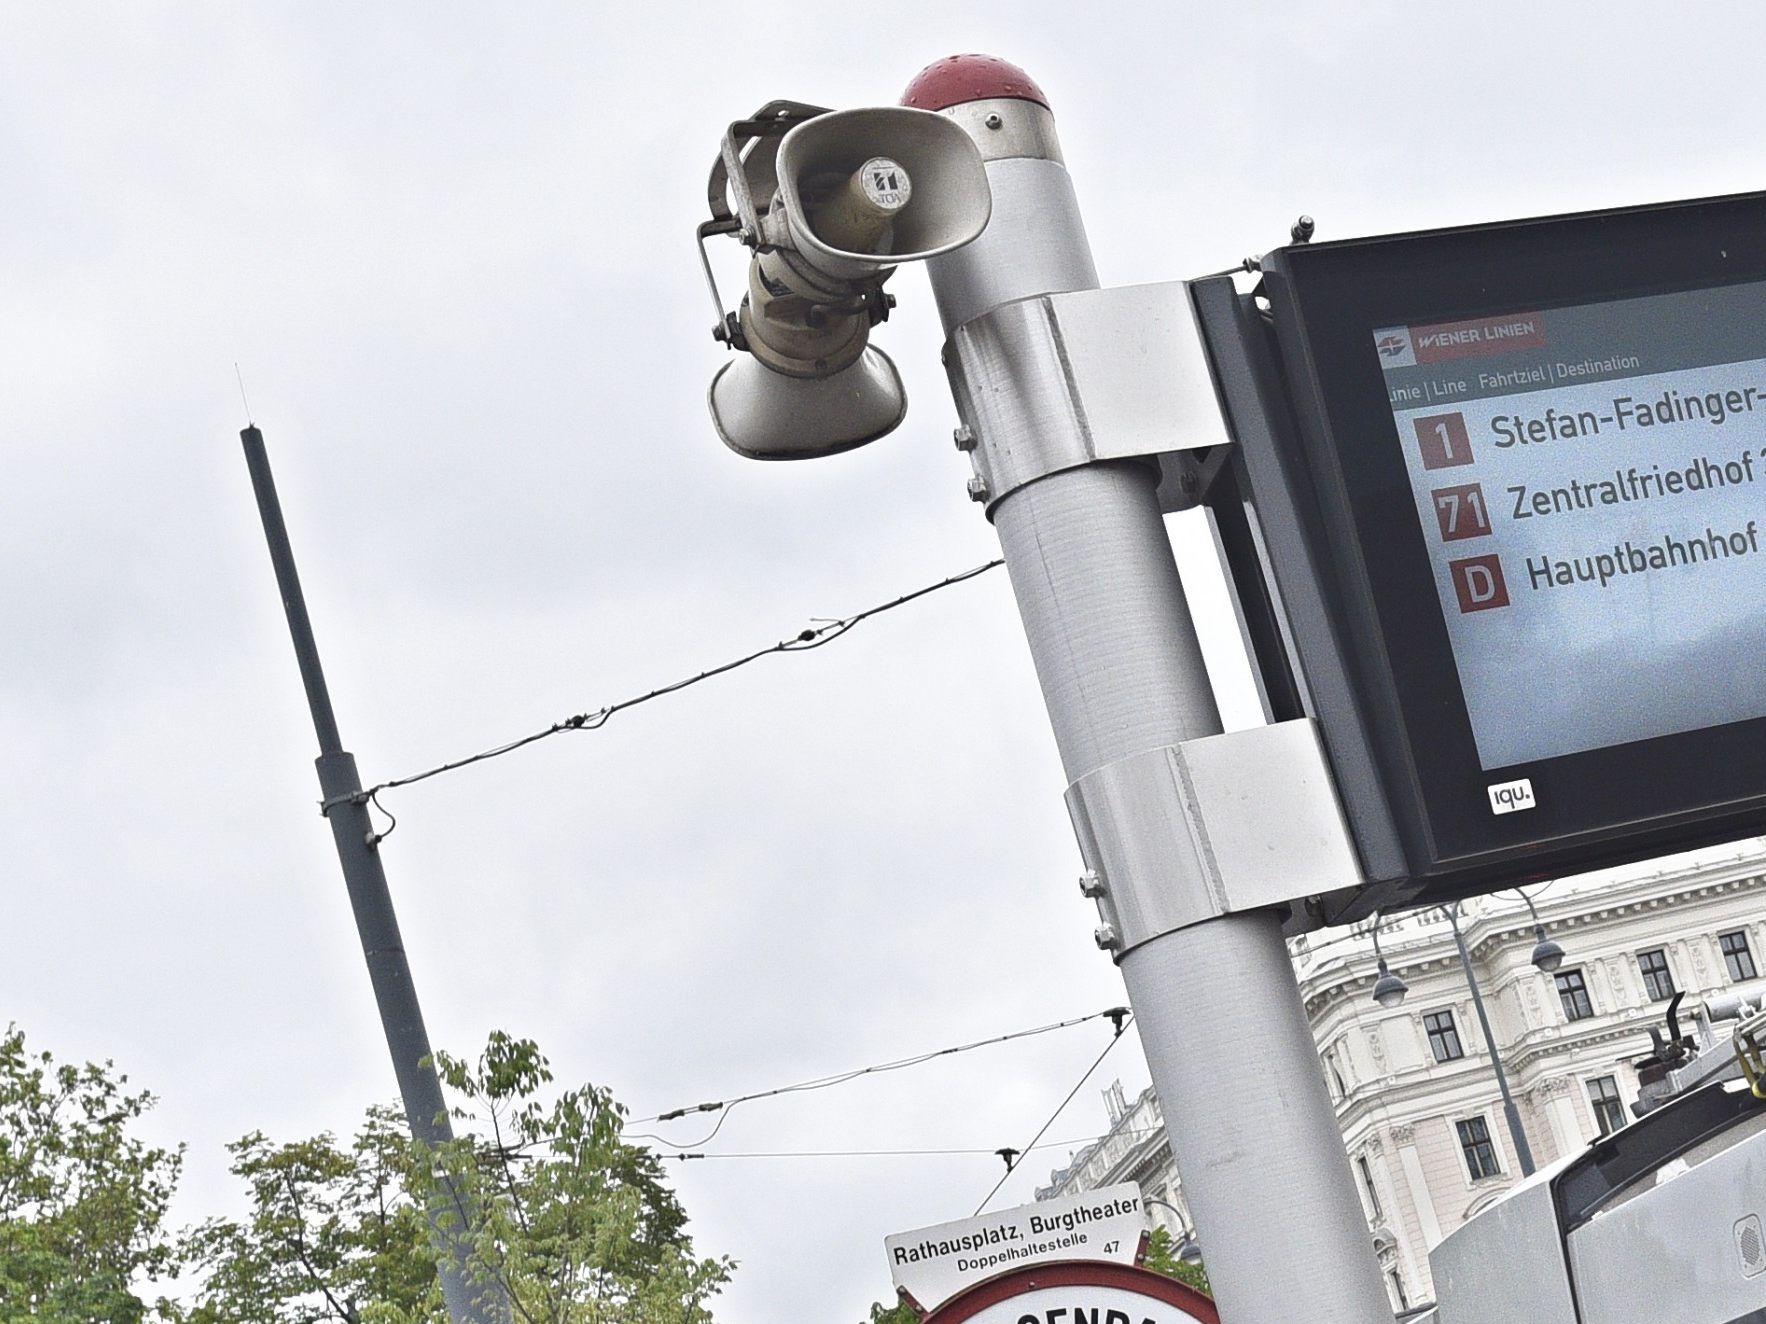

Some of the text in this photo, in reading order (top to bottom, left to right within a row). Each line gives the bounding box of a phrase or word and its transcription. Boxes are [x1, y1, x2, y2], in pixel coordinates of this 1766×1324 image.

[1418, 321, 1535, 348] WIENER LINIEN
[1389, 354, 1640, 402] inie Line Fahrtziel Destination
[1434, 422, 1454, 459] 1
[1438, 490, 1488, 534] 71
[1507, 451, 1754, 521] Zentralfriedhof
[1464, 563, 1496, 605] D
[1525, 521, 1759, 591] Hauptbahnhof
[893, 1196, 1140, 1266] Rathausplatz, Burgtheater
[957, 1231, 1122, 1273] Doppelhaltestelle 47
